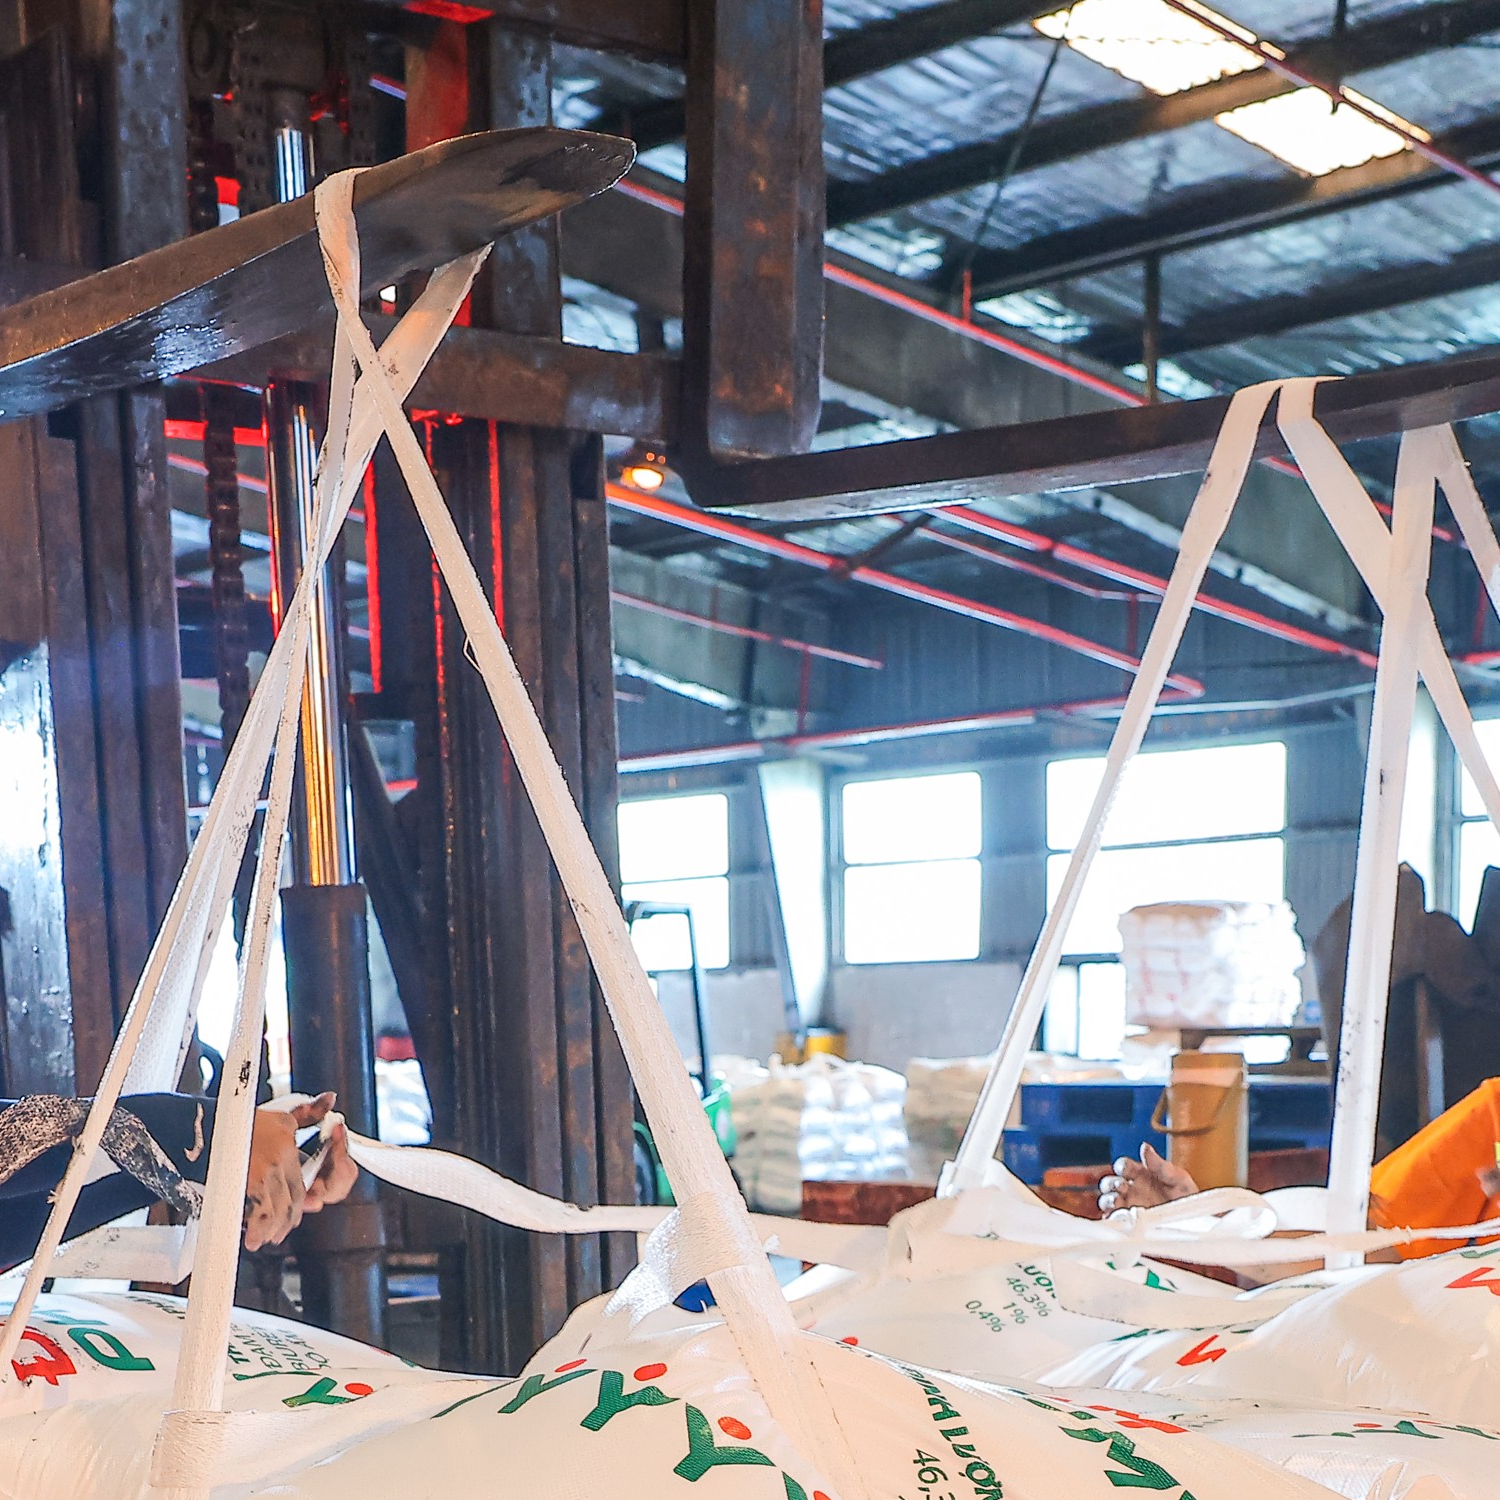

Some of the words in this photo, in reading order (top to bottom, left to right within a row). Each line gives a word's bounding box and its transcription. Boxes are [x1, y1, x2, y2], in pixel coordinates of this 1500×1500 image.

[1003, 1302, 1029, 1324] 1%
[1006, 1277, 1052, 1317] 46,3%
[965, 1300, 1006, 1332] 0,4%
